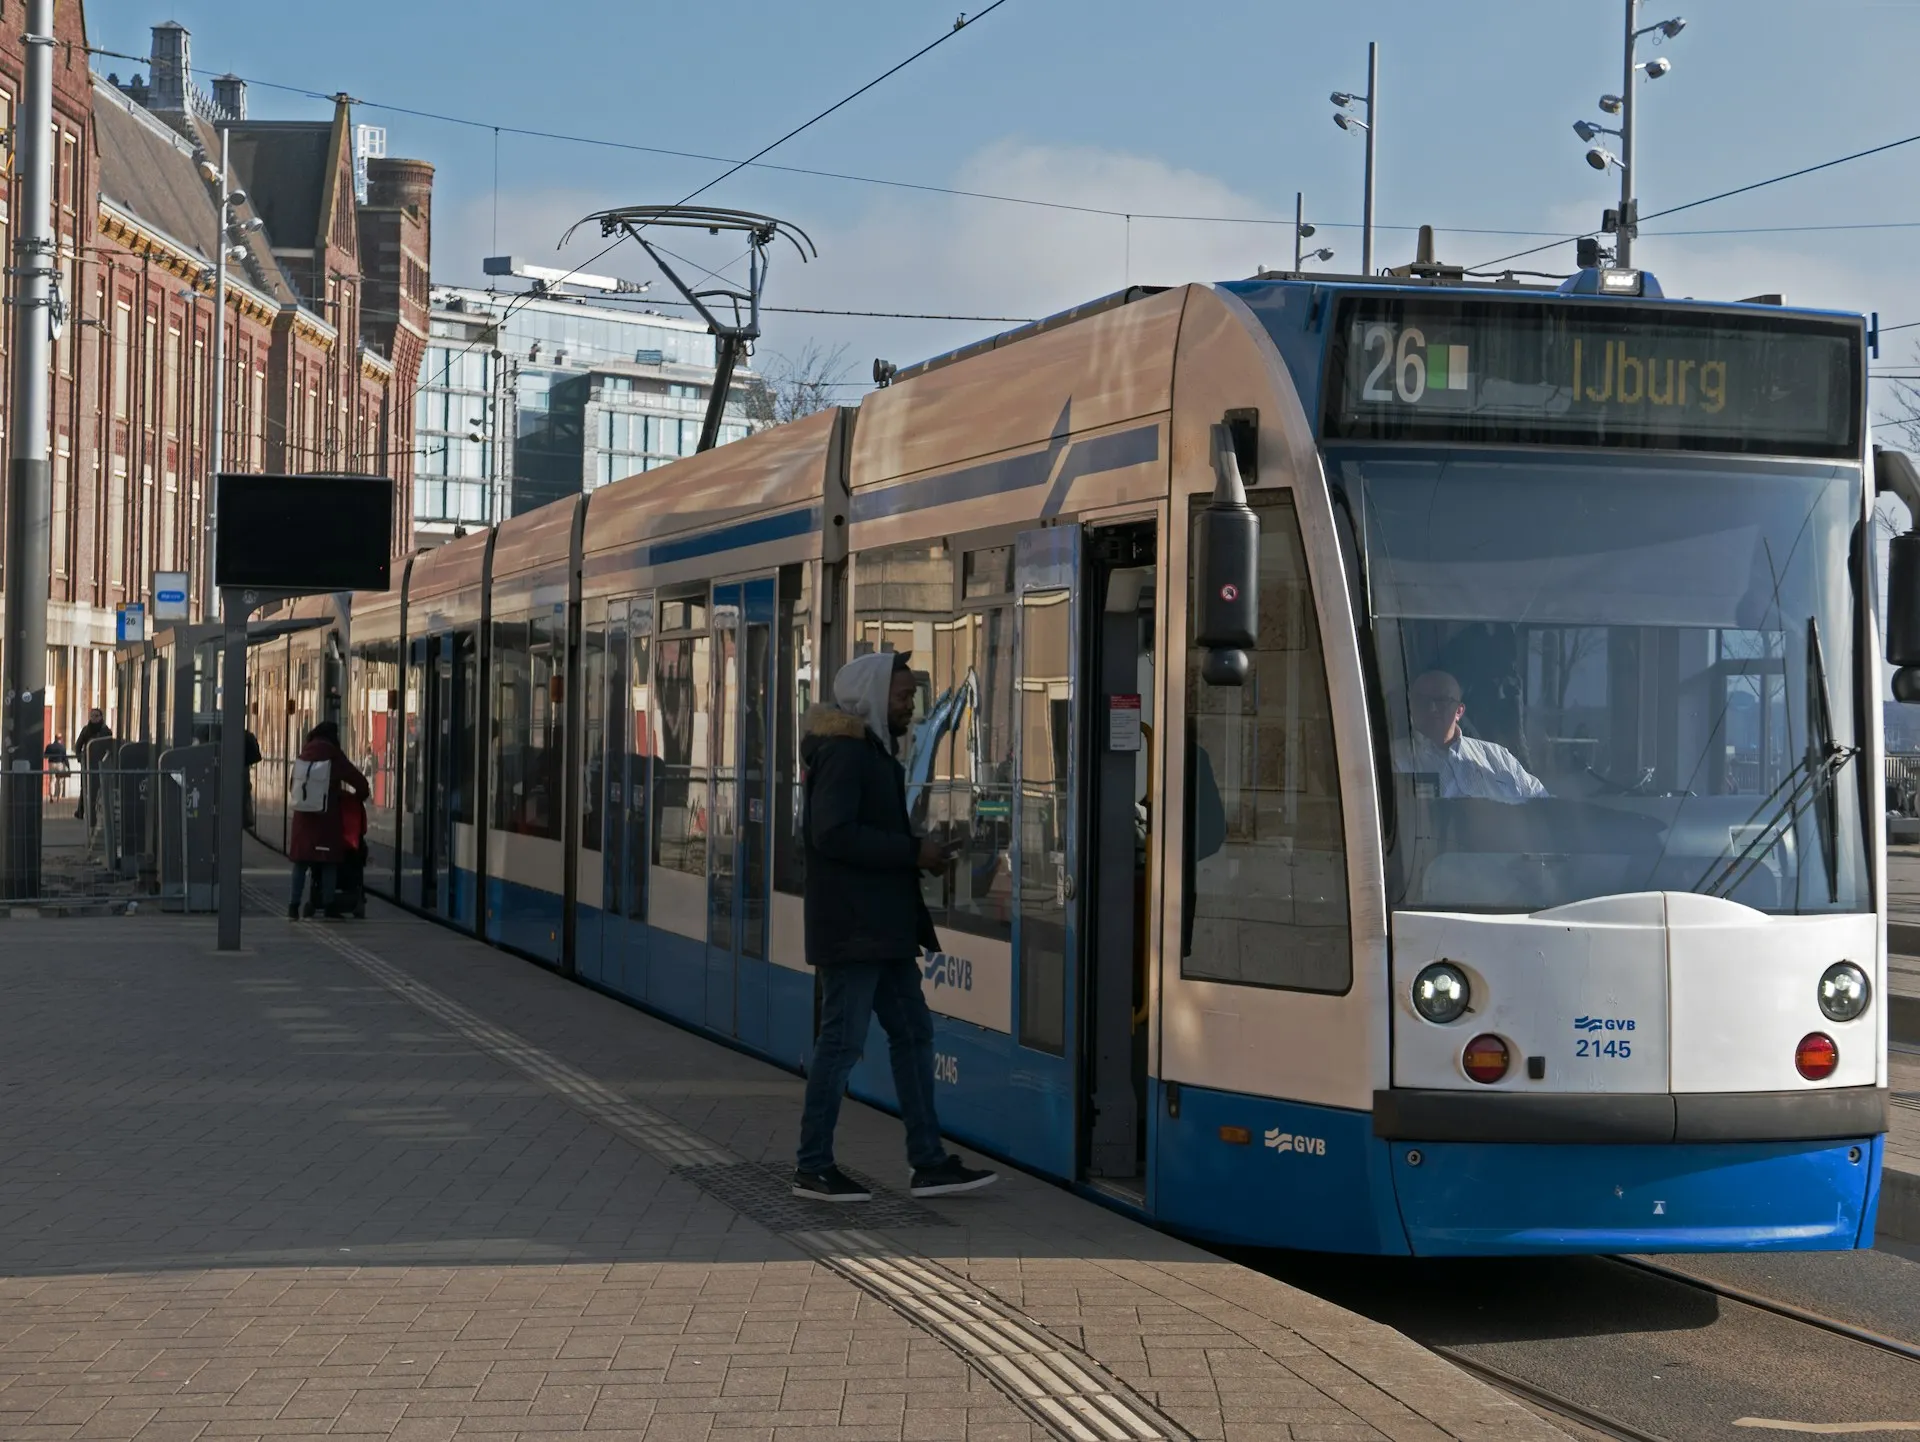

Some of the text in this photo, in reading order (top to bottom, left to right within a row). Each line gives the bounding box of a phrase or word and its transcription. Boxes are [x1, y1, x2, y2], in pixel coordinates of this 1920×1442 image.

[1362, 326, 1727, 413] 26 IJburg
[126, 617, 136, 626] 26
[947, 955, 973, 992] GVB
[1604, 1019, 1636, 1031] GVB
[1576, 1039, 1631, 1058] 2145
[934, 1052, 958, 1085] 2145
[1294, 1135, 1326, 1155] GVB
